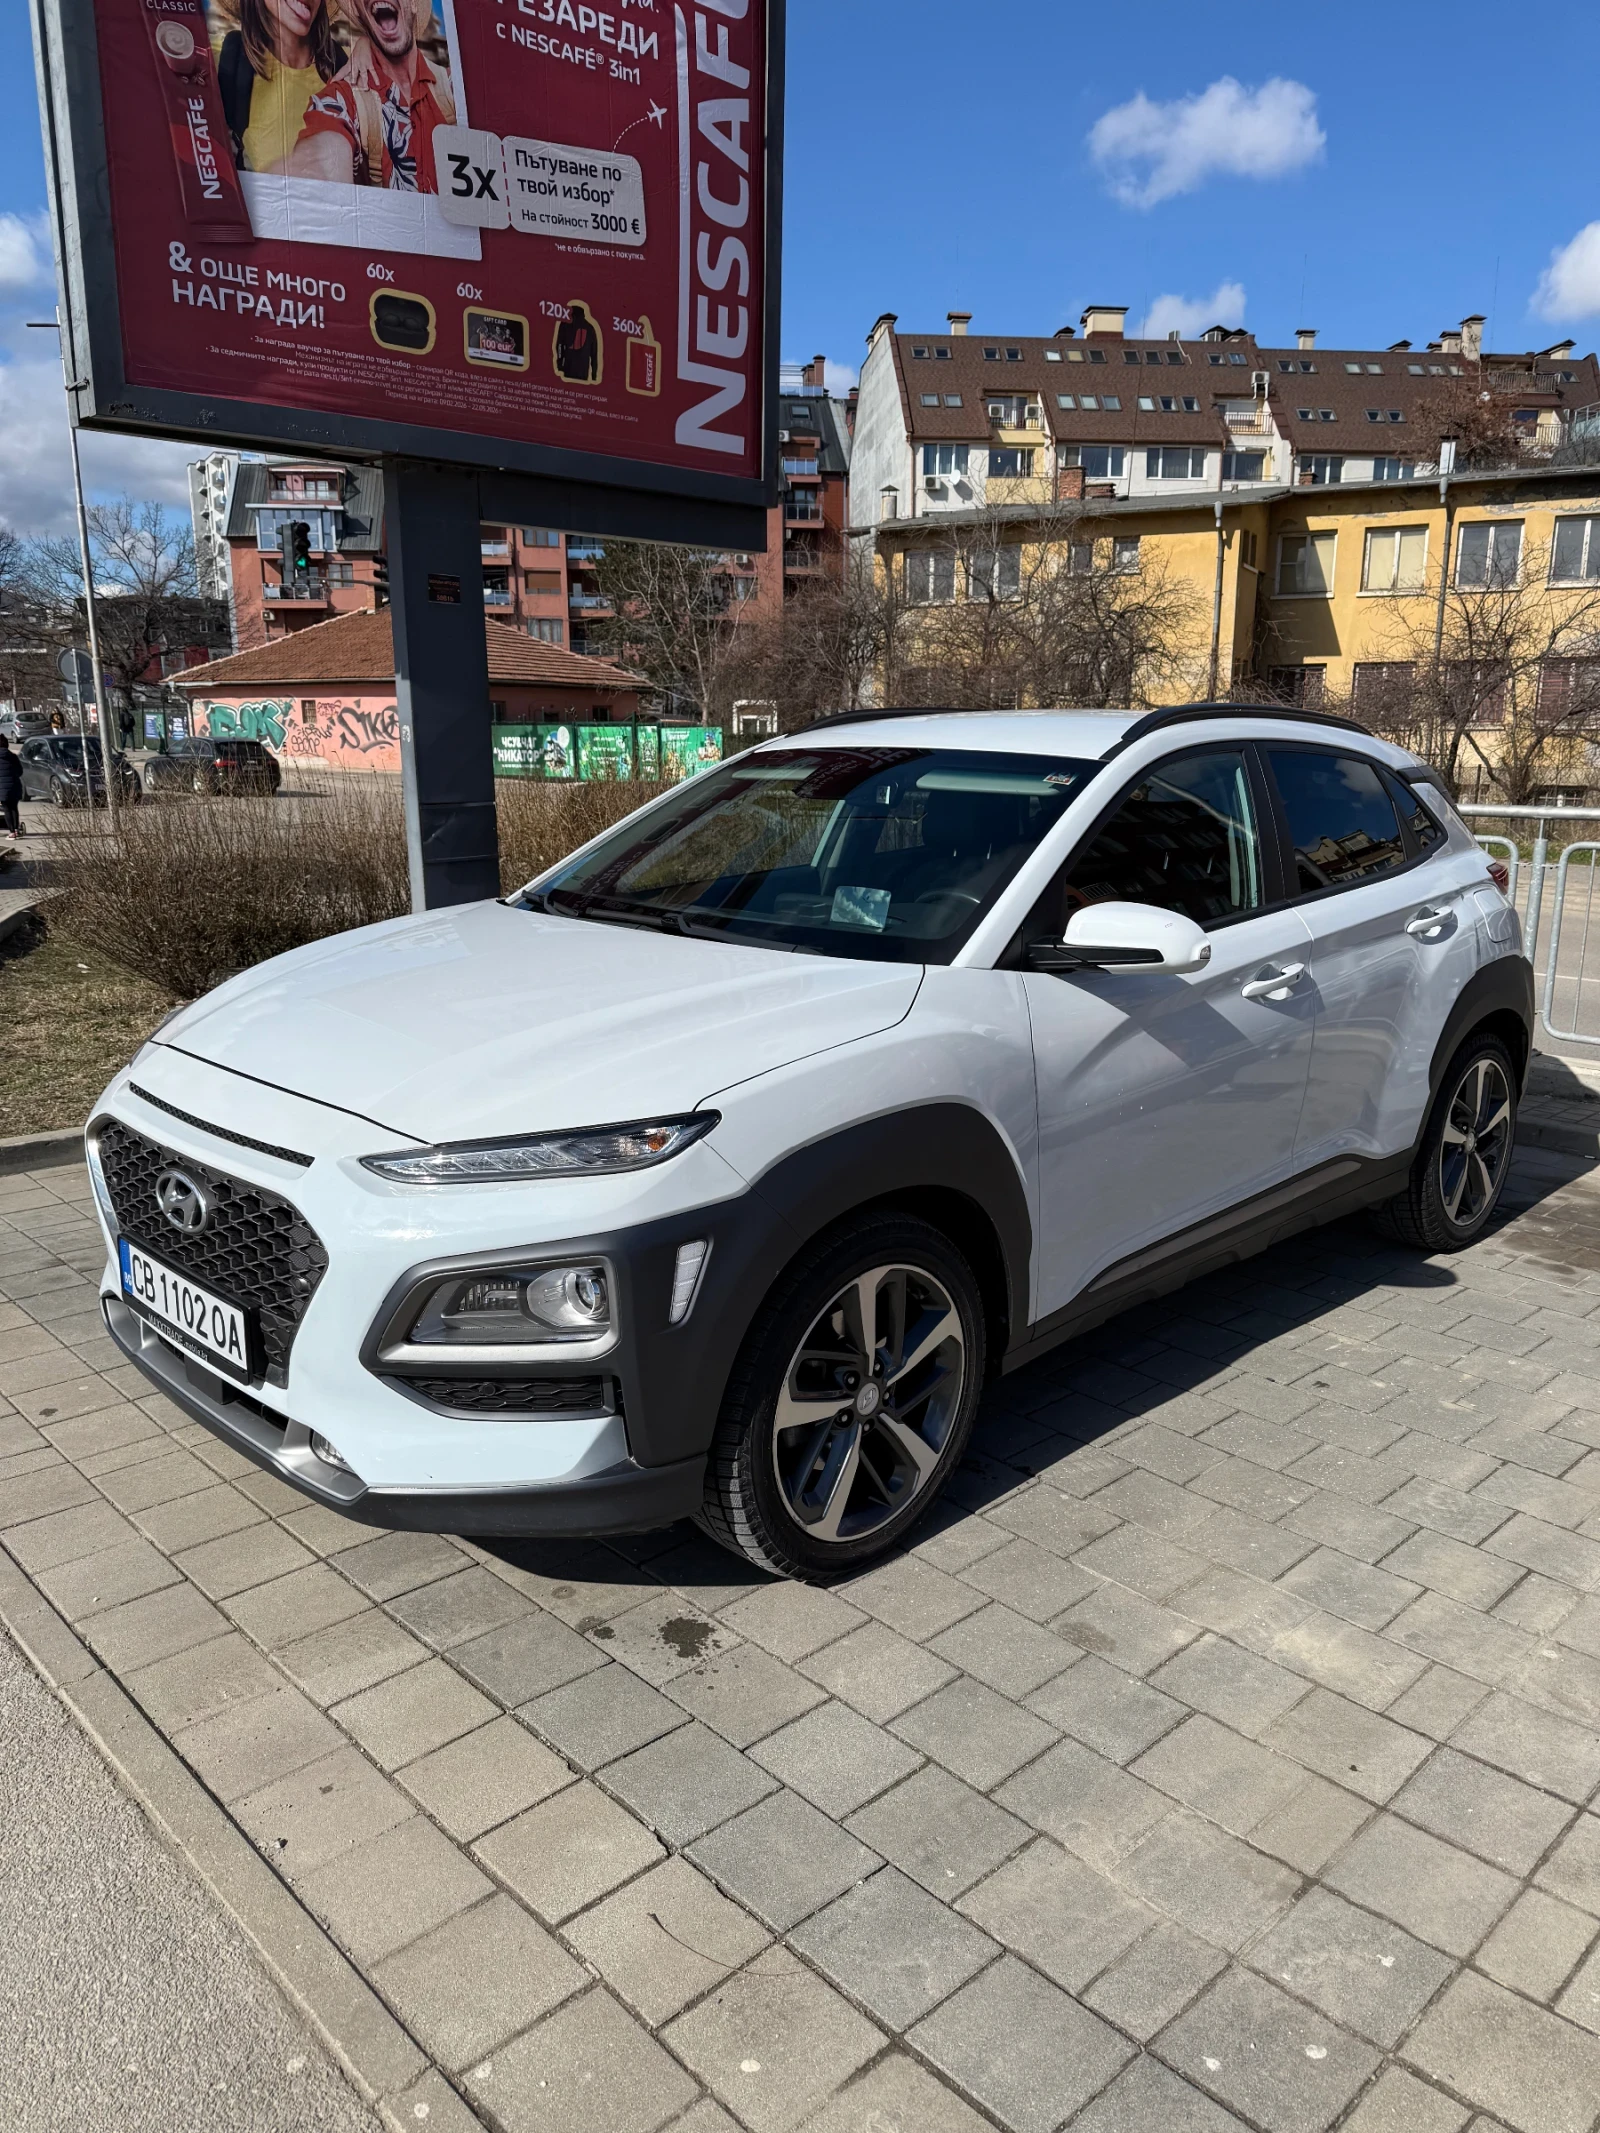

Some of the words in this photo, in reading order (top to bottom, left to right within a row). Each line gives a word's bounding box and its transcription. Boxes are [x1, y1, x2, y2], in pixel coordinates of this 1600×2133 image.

[147, 0, 196, 12] CLASSIC
[496, 23, 506, 39] с
[609, 58, 641, 86] 3in1
[515, 149, 598, 179] Пътуване
[602, 165, 622, 182] по
[517, 178, 557, 197] твой
[521, 209, 537, 222] На
[539, 213, 589, 230] стойност
[590, 213, 628, 234] 3000
[631, 218, 640, 235] €
[674, 0, 750, 456] NESCAF
[169, 241, 194, 274] &
[200, 258, 259, 287] ОЩЕ
[266, 269, 346, 302] МНОГО
[172, 278, 325, 329] НАГРАДИ!
[482, 338, 496, 350] 100
